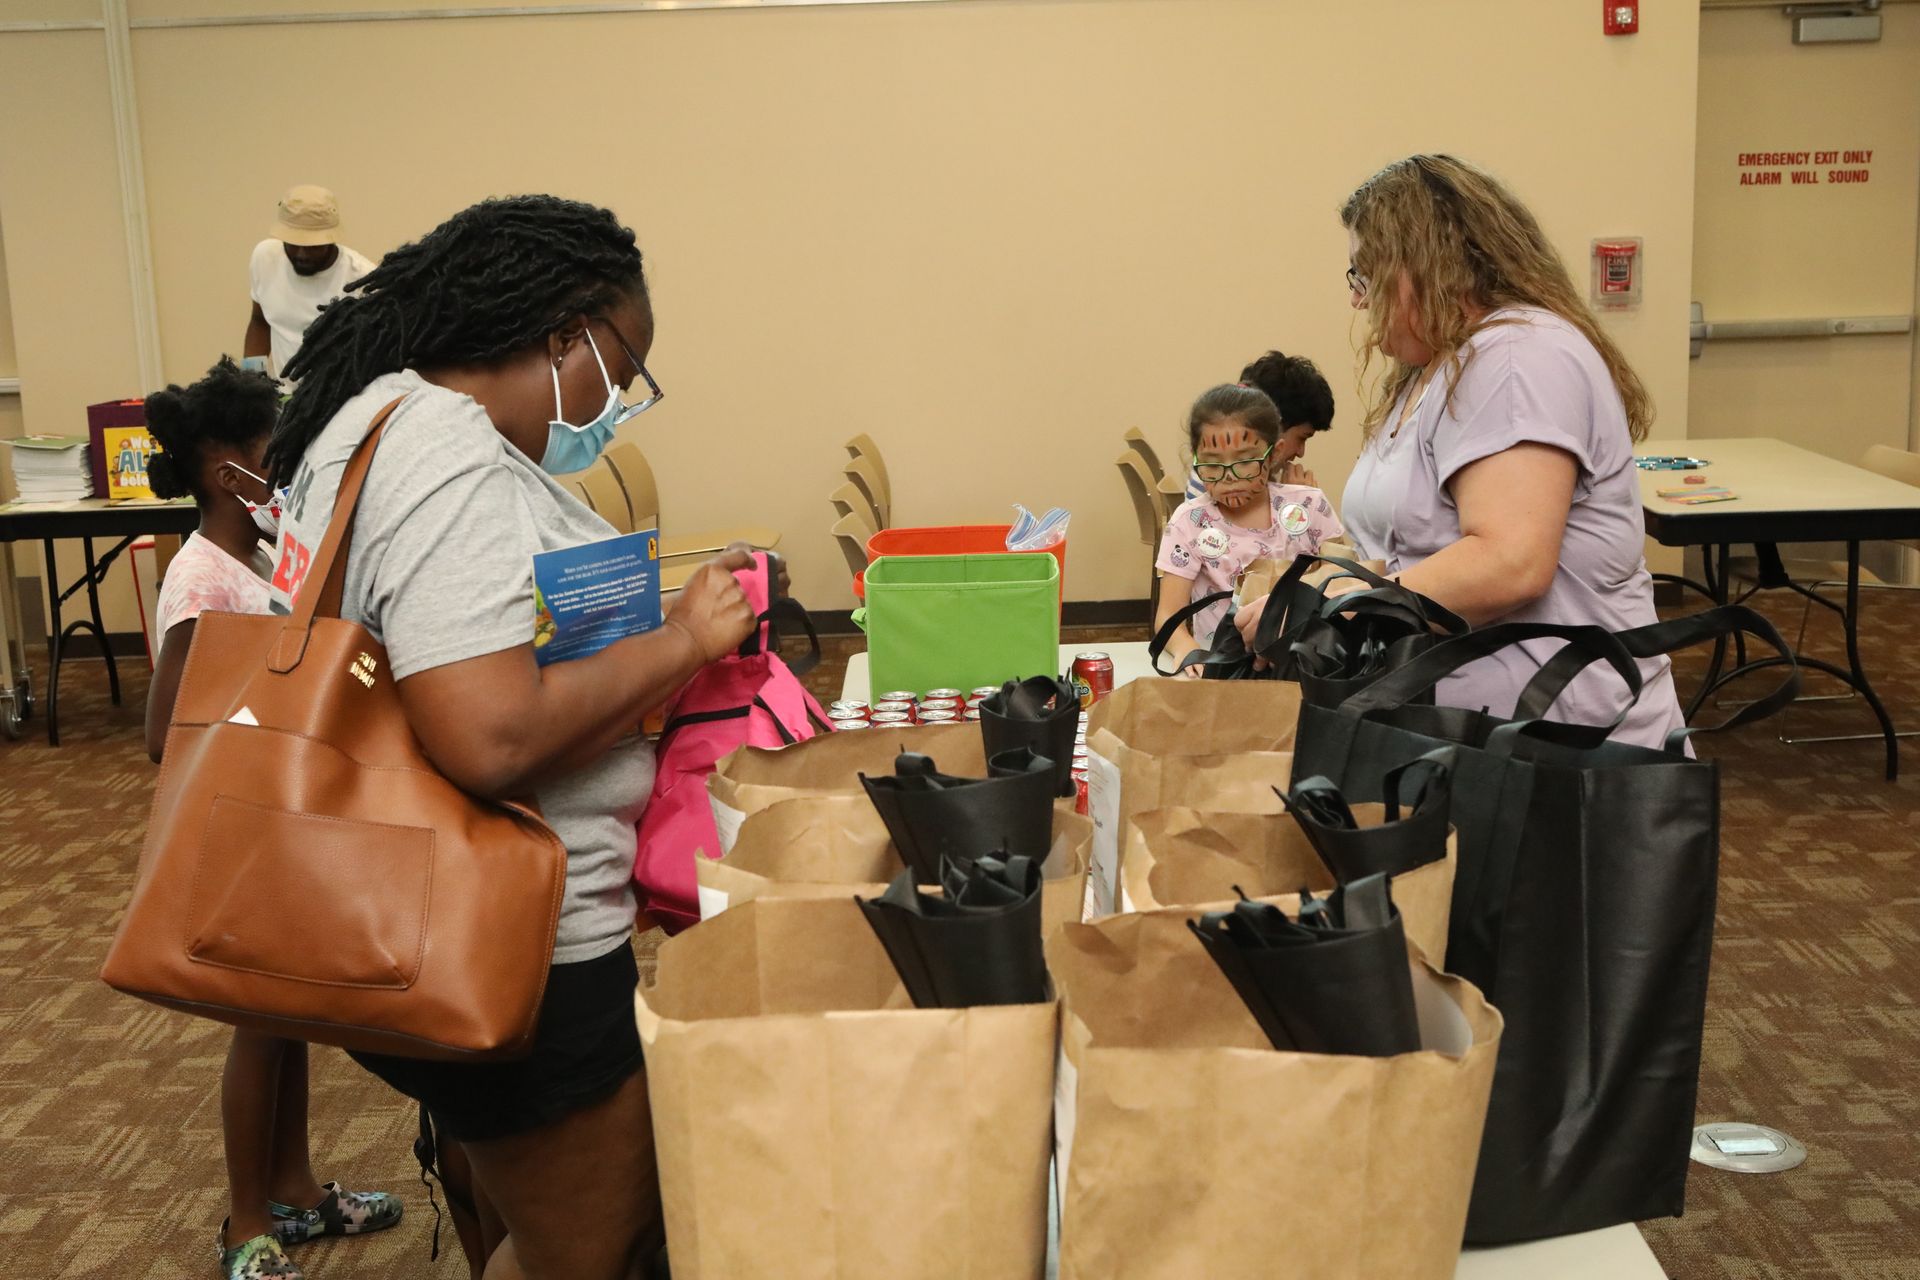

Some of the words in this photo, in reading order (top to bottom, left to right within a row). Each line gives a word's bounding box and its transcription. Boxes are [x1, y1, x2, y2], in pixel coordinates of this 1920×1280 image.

[1738, 152, 1811, 166] EMERGENCY
[1814, 151, 1839, 165] EXIT
[1843, 150, 1873, 164] ONLY
[1740, 172, 1782, 186] ALARM
[1791, 171, 1819, 184] WILL
[1828, 170, 1869, 183] SOUND
[118, 449, 156, 473] AL
